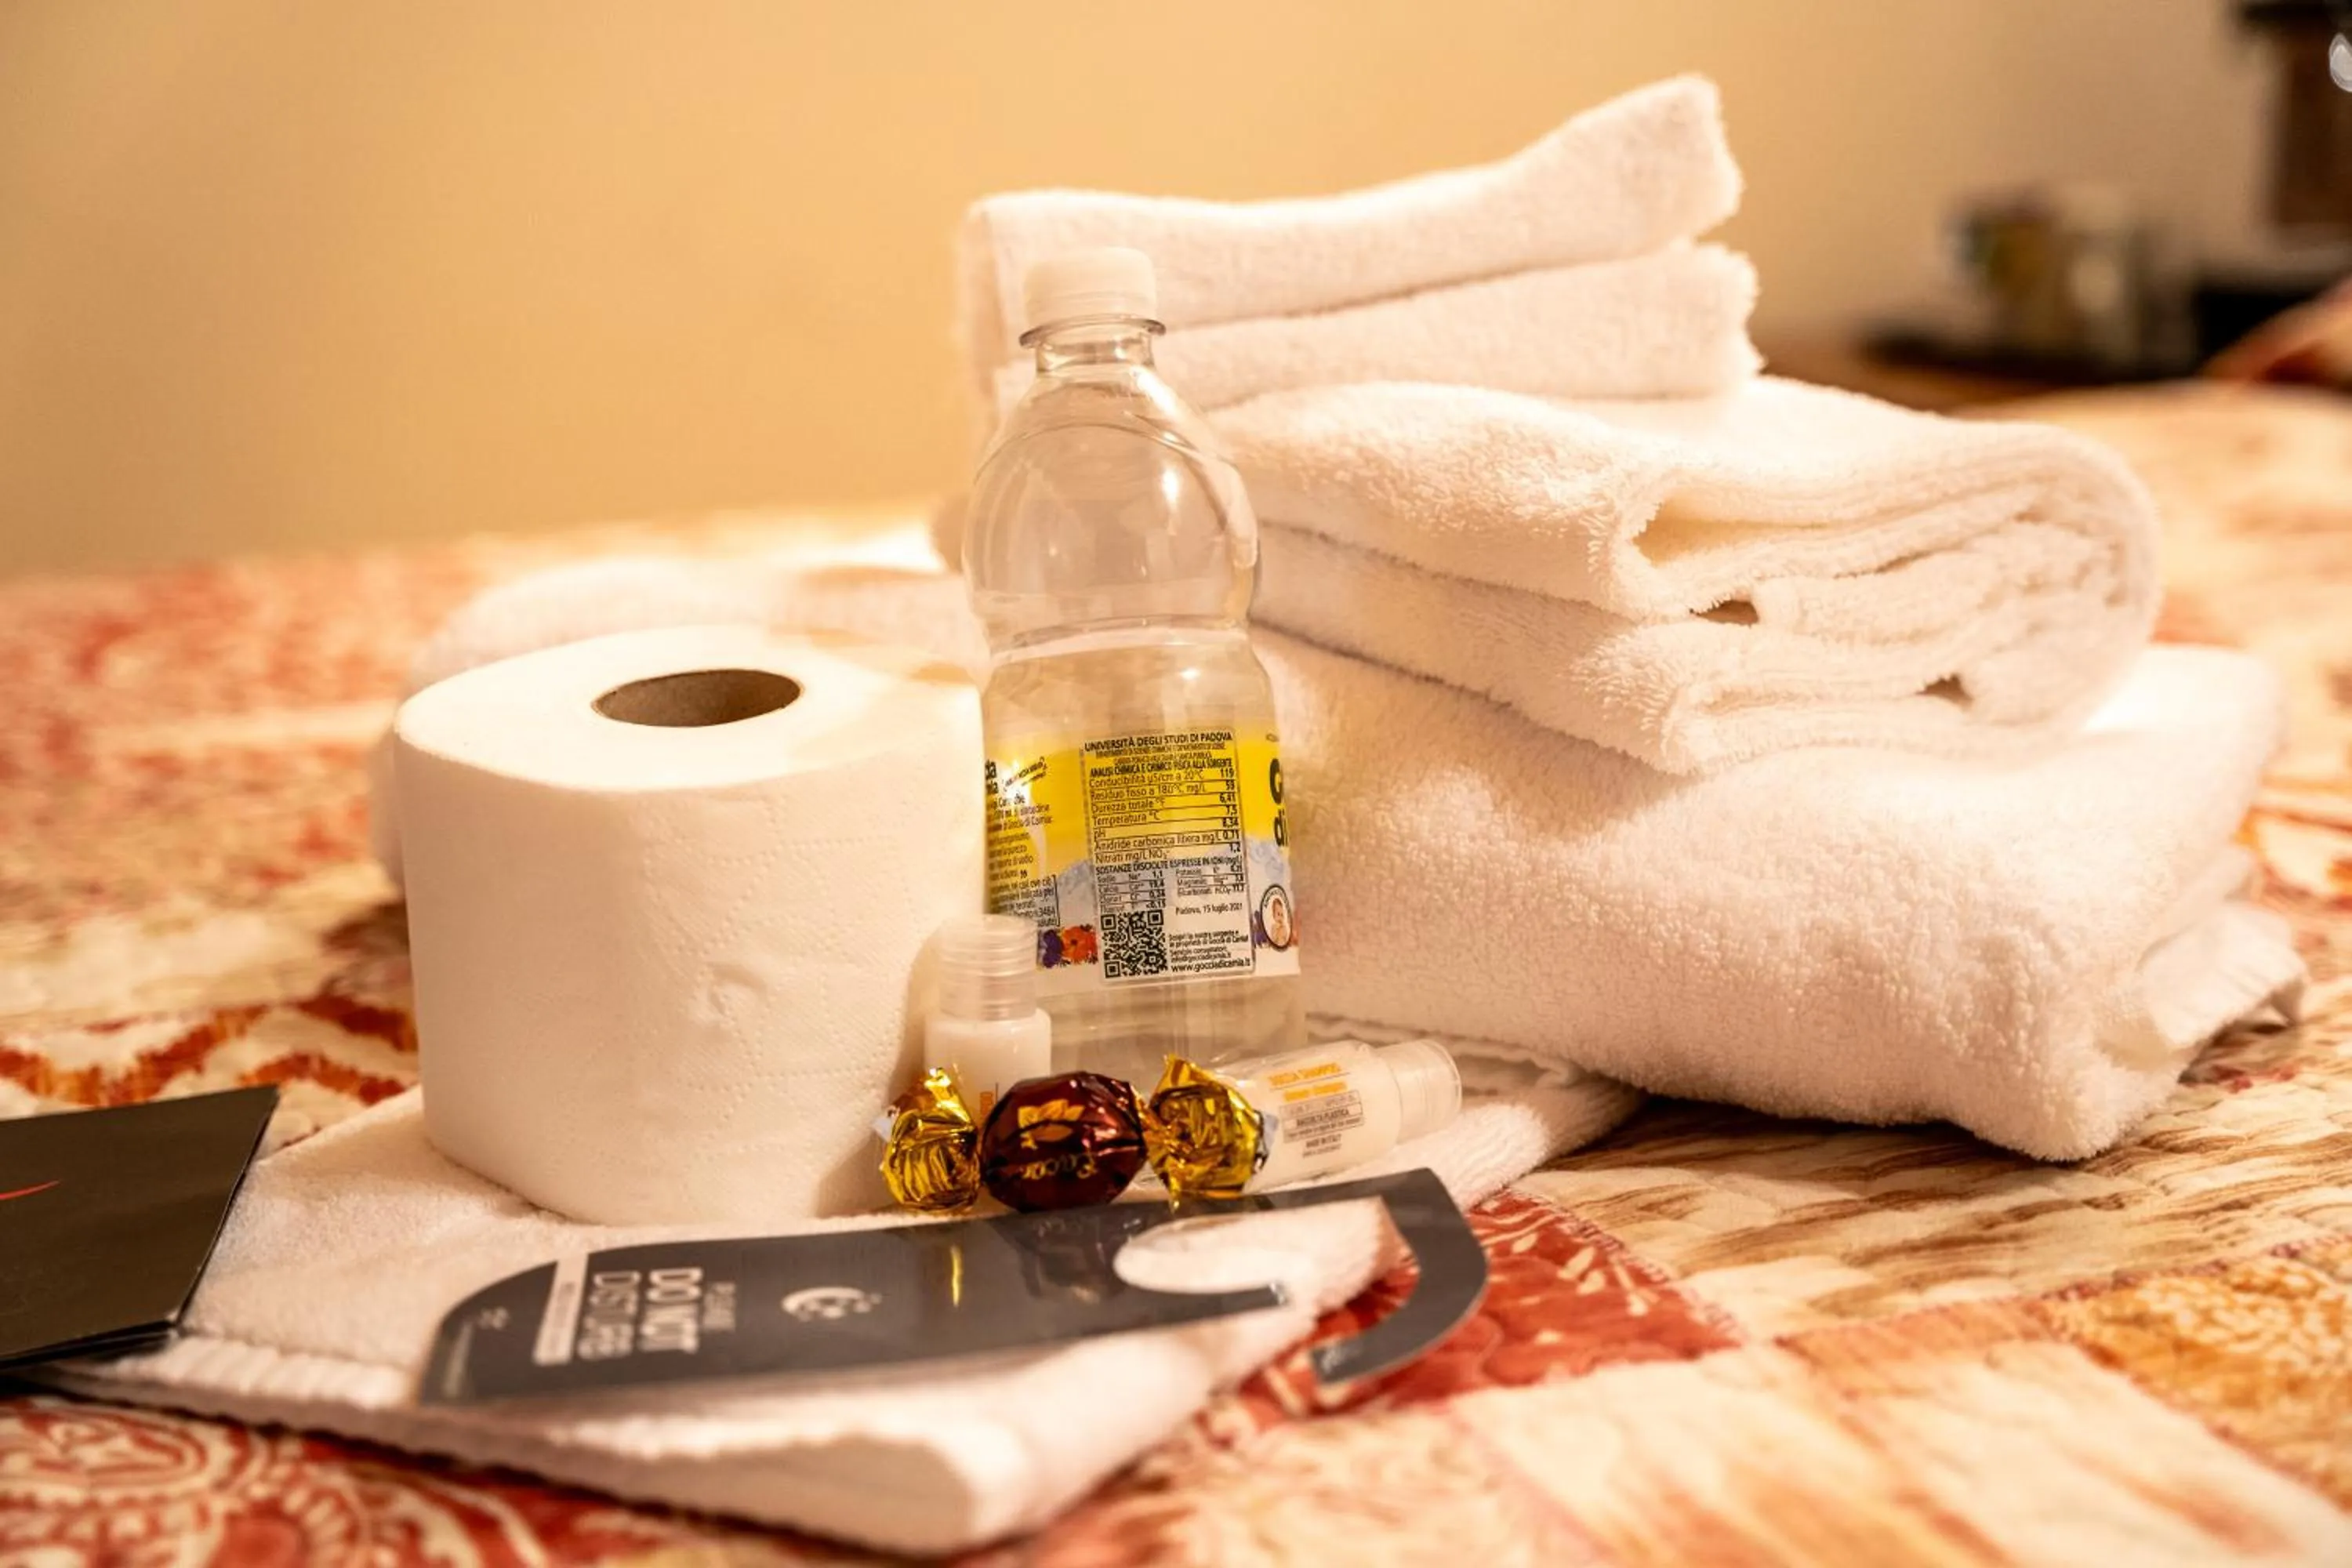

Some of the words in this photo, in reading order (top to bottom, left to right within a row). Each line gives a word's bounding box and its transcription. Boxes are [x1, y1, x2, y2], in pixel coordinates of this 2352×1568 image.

[1084, 736, 1135, 752] UNIVERSITÀ
[1137, 736, 1163, 747] DEGLI
[1164, 734, 1189, 745] STUDI
[1200, 731, 1233, 742] PADOVA
[1093, 811, 1147, 827] Temperatura
[1095, 851, 1124, 864] Nitrati
[645, 1267, 702, 1304] DO
